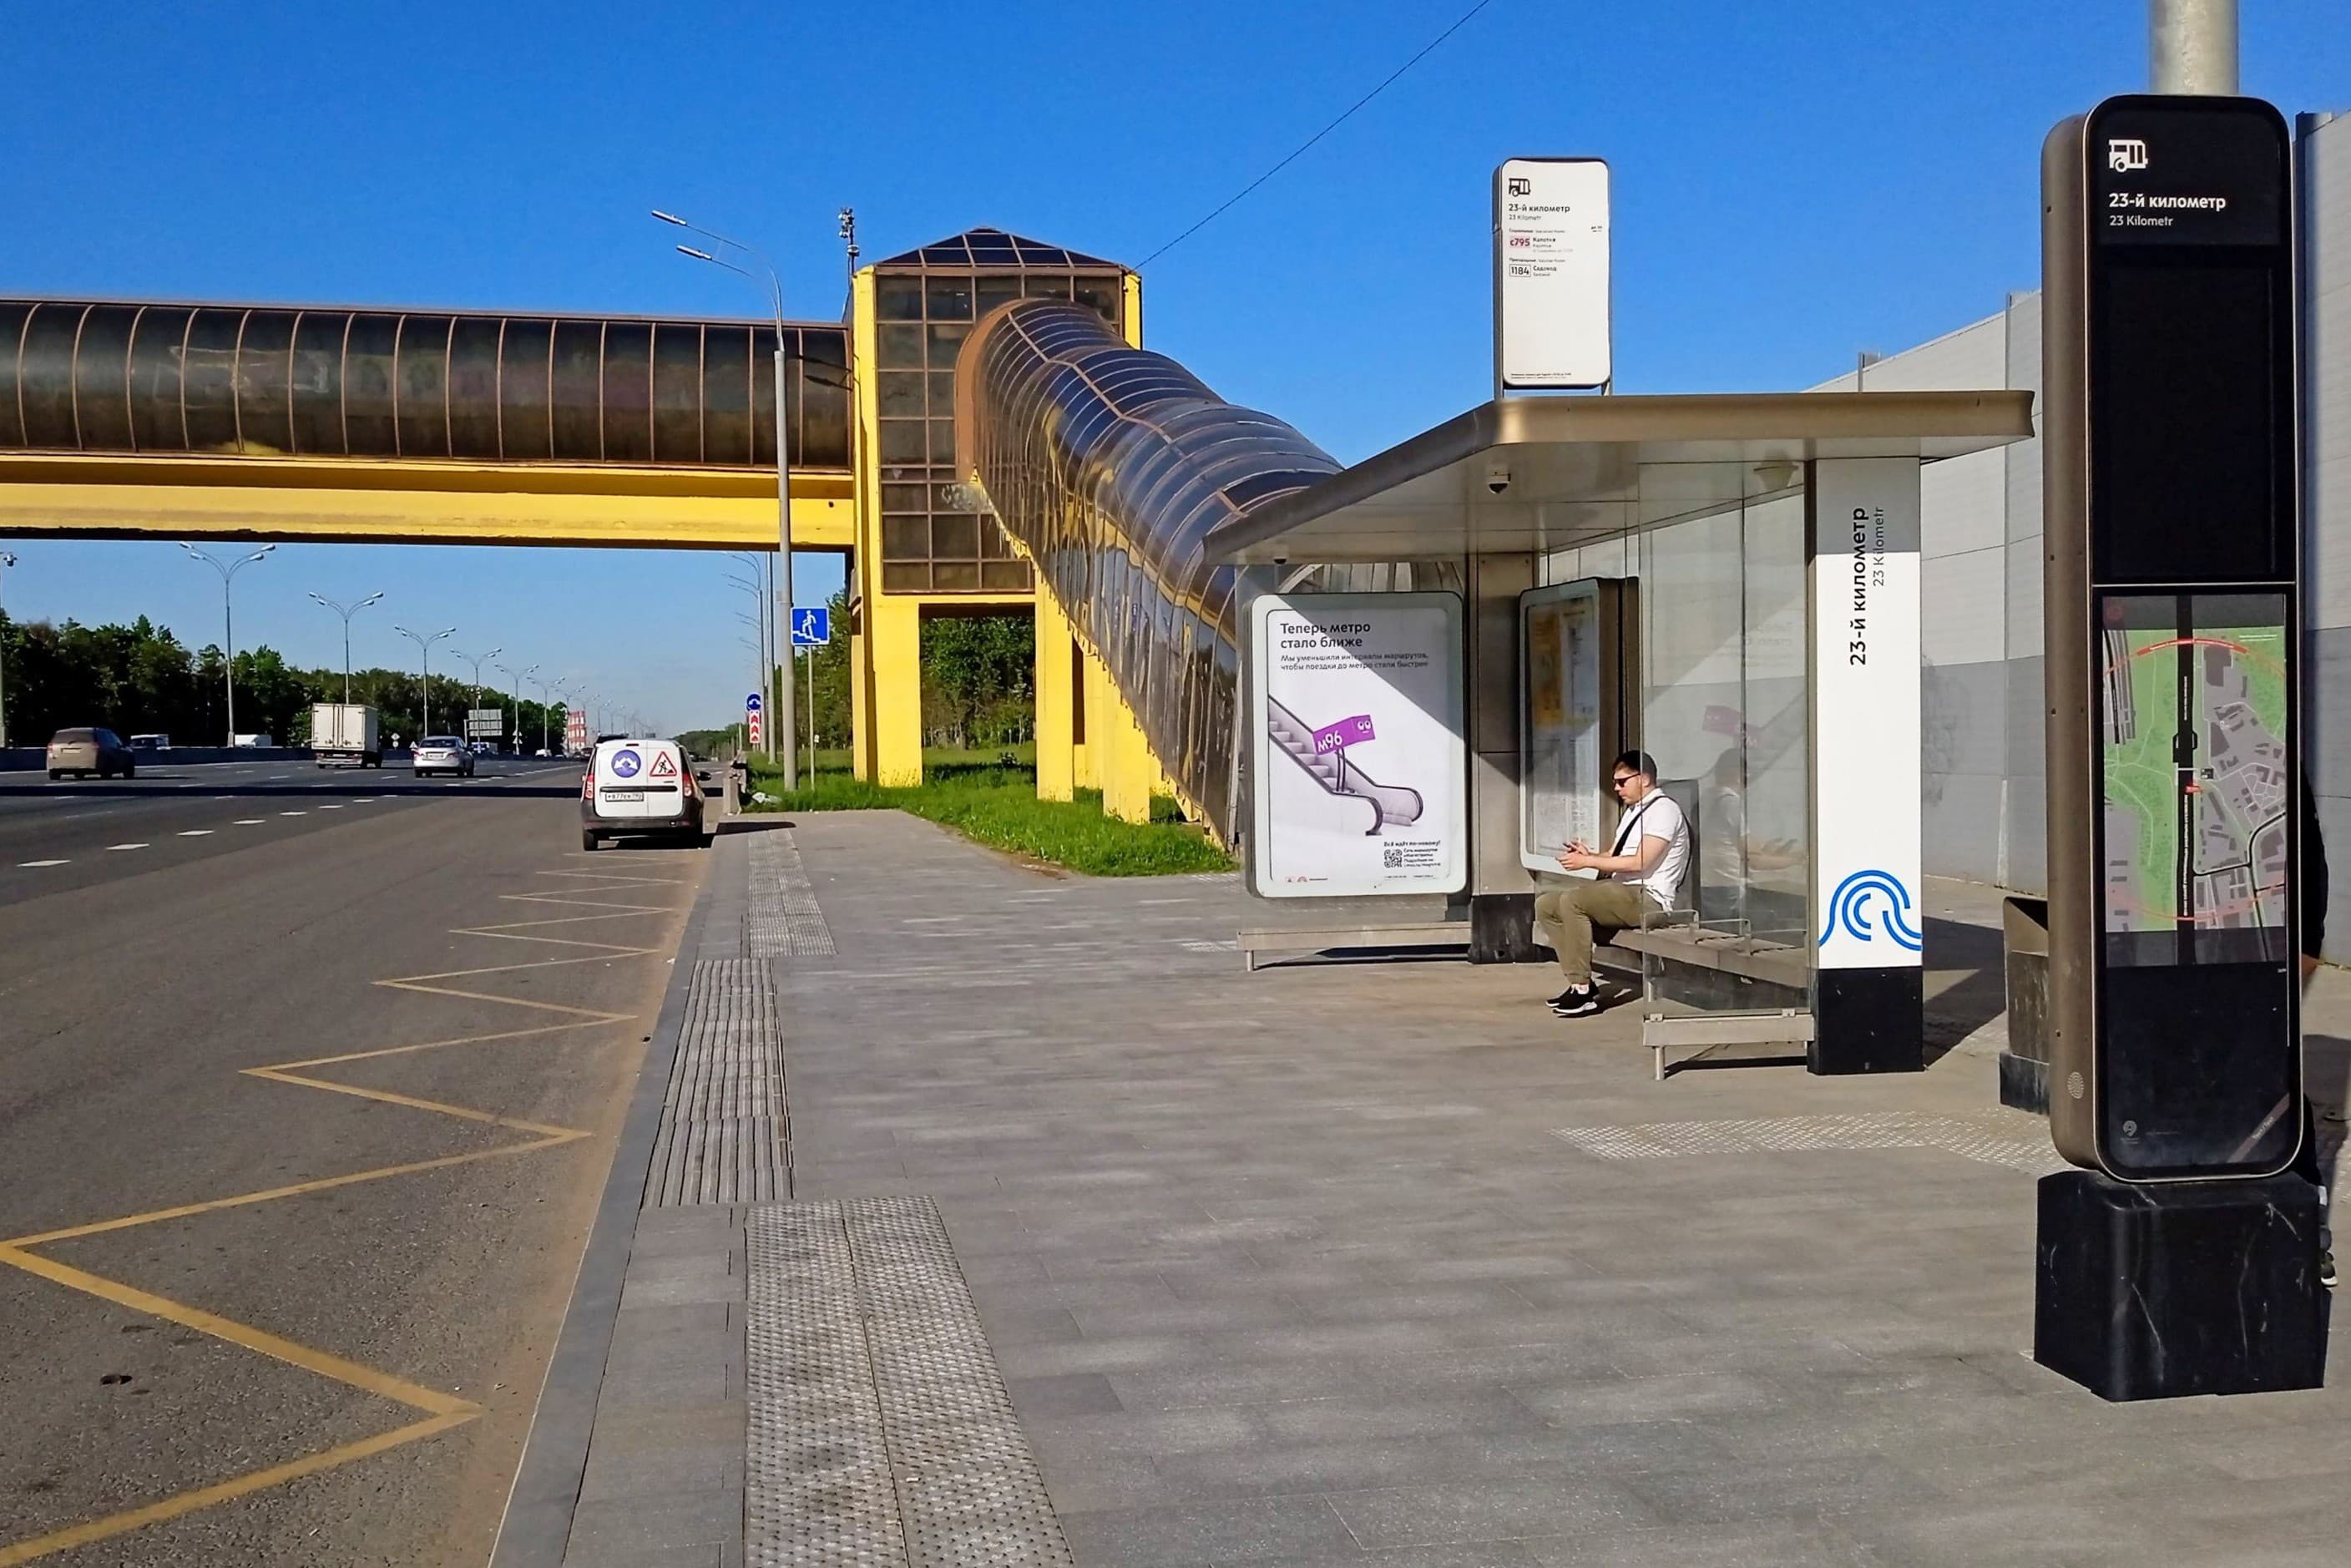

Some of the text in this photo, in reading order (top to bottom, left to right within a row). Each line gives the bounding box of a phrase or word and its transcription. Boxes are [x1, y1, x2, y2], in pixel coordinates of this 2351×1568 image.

[2108, 192, 2227, 212] 23-й километр
[1508, 203, 1570, 213] 23-й километр
[2109, 215, 2174, 226] 23 Kilometr
[1510, 266, 1529, 275] 1184
[1873, 507, 1884, 586] 23 Kilometr
[1849, 507, 1869, 665] 23-й километр
[1280, 622, 1371, 635] Теперь метро
[1280, 636, 1363, 648] стало ближе
[1297, 655, 1340, 663] уменьшили
[1341, 654, 1383, 662] интервалы
[1281, 662, 1304, 670] чтобы
